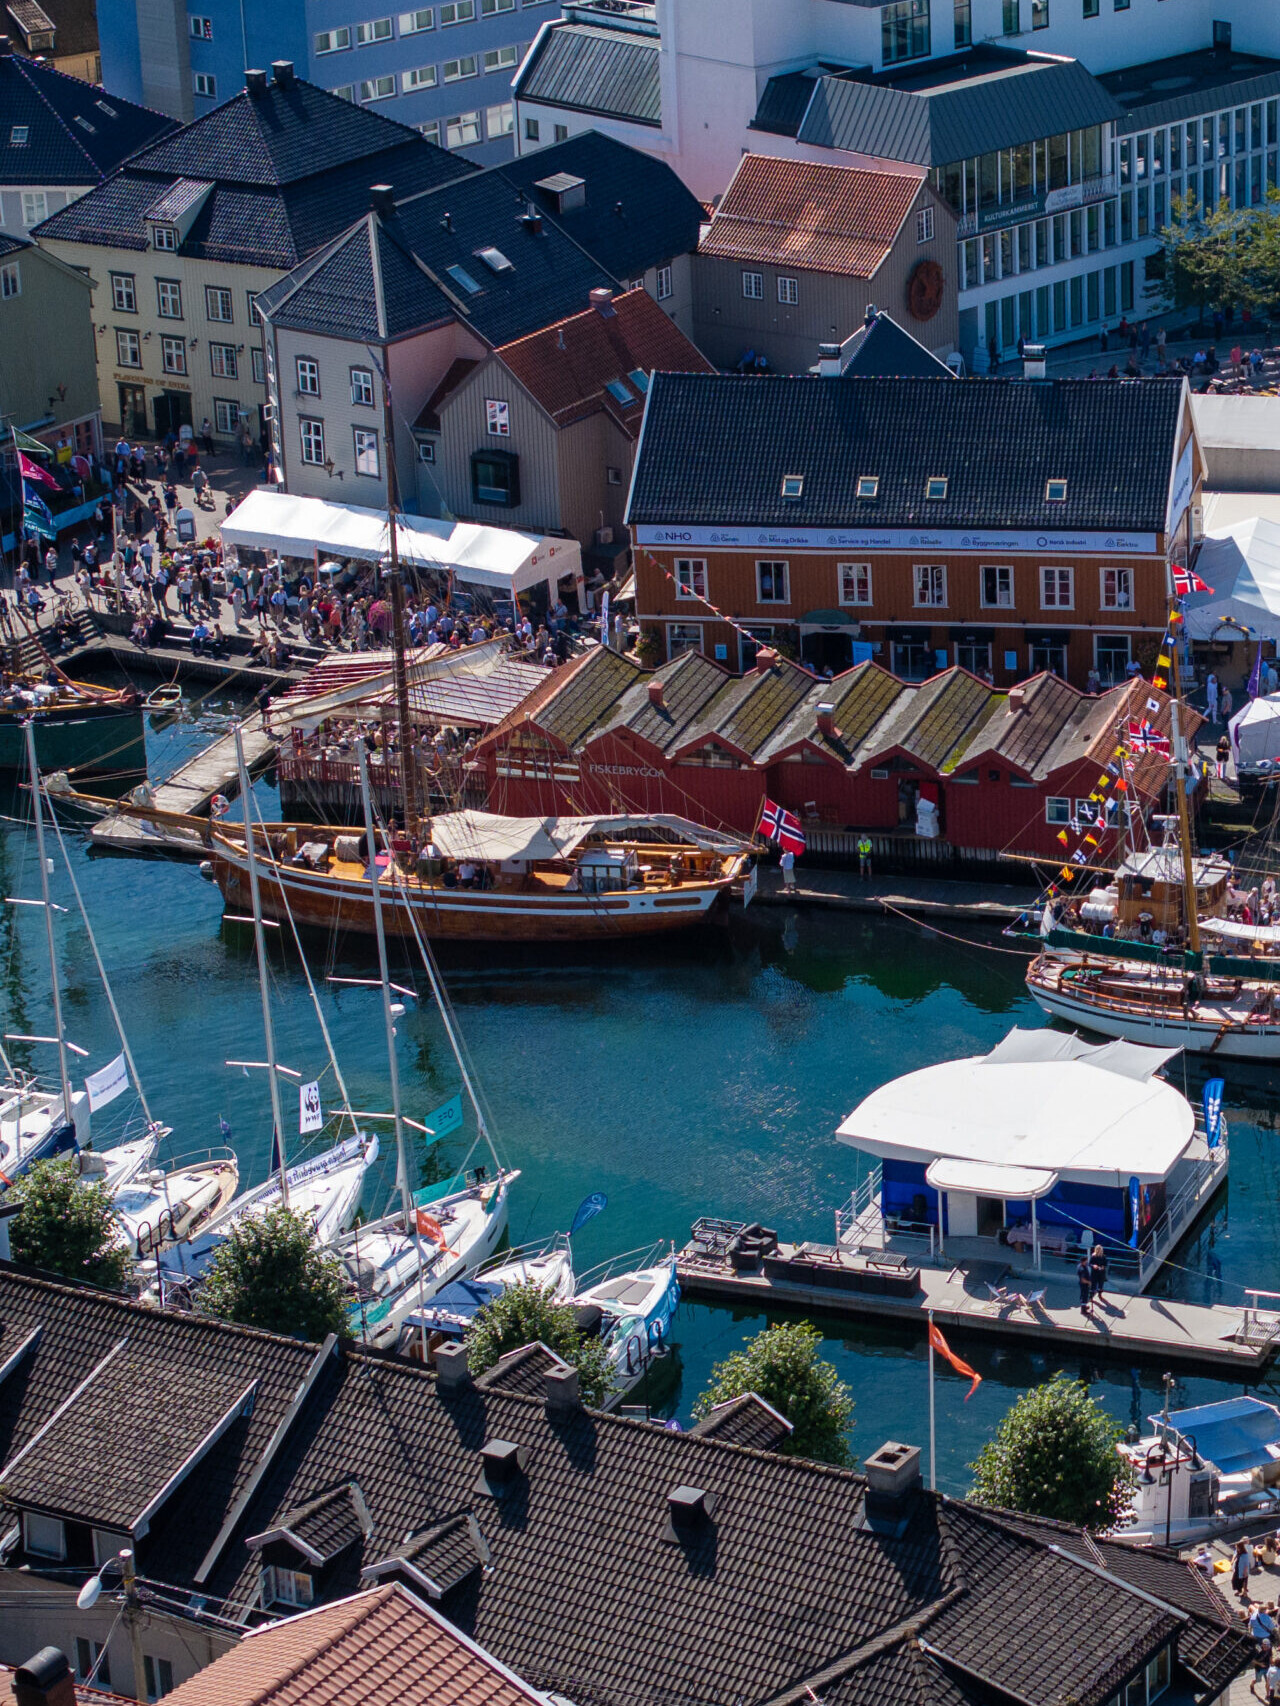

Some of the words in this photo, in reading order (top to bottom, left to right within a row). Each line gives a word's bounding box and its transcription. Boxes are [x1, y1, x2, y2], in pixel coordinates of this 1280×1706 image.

[984, 202, 1039, 222] KULTURKAMMERET
[665, 532, 692, 541] NHO
[305, 1113, 320, 1124] WWF
